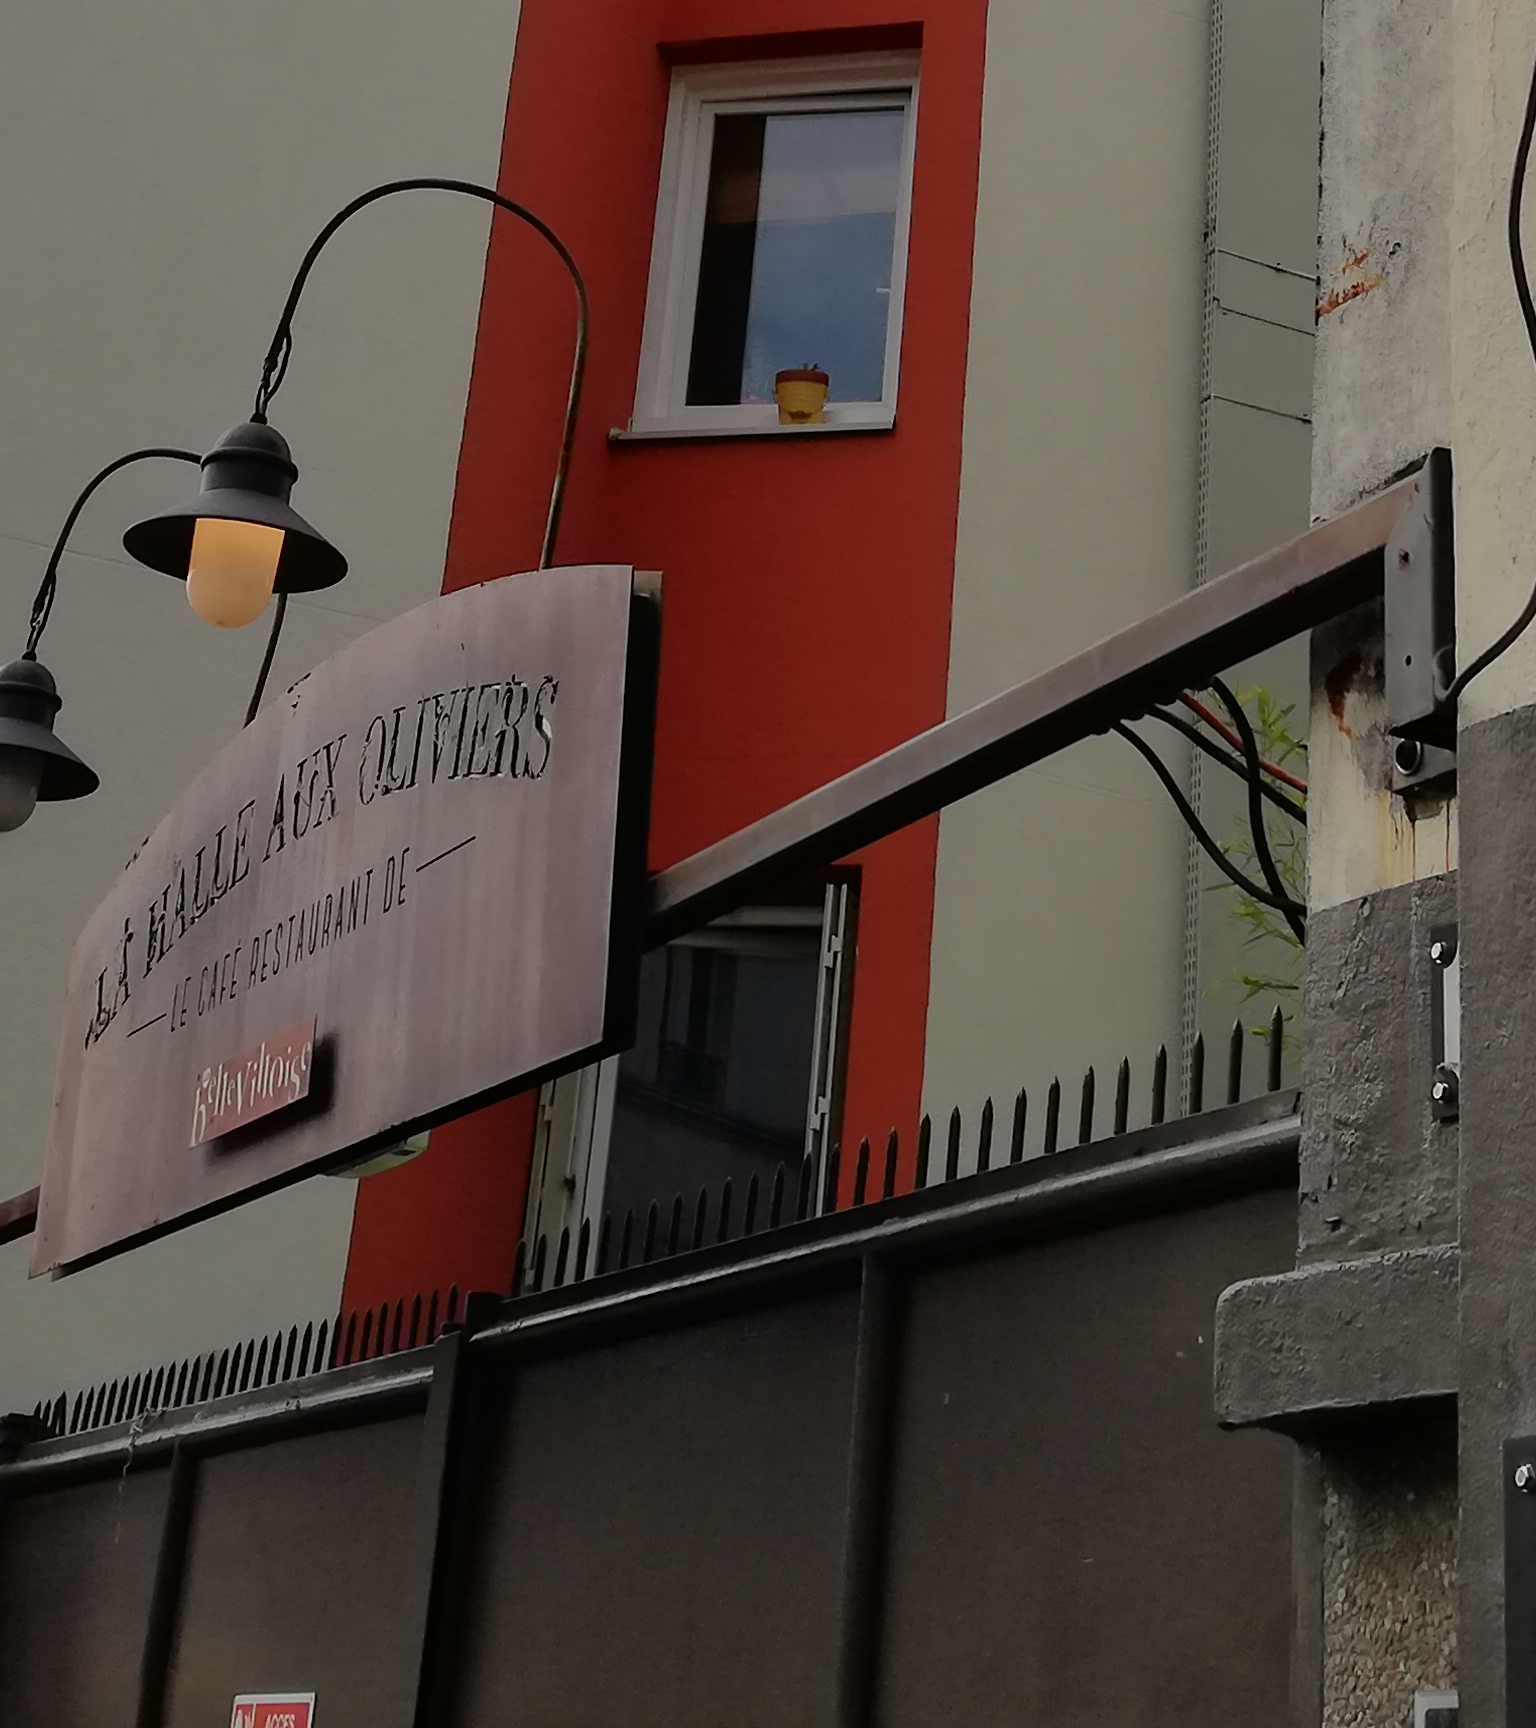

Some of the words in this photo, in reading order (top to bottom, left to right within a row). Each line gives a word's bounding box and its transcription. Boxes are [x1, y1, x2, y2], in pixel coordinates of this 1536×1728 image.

[84, 917, 134, 1050] LA
[143, 798, 256, 979] HALLE
[261, 734, 348, 863] AUX
[358, 674, 560, 806] OLIVIERS
[170, 975, 192, 1034] LE
[197, 939, 243, 1017] CAFÉ
[247, 868, 374, 991] RESTAURANT
[382, 847, 410, 914] DE
